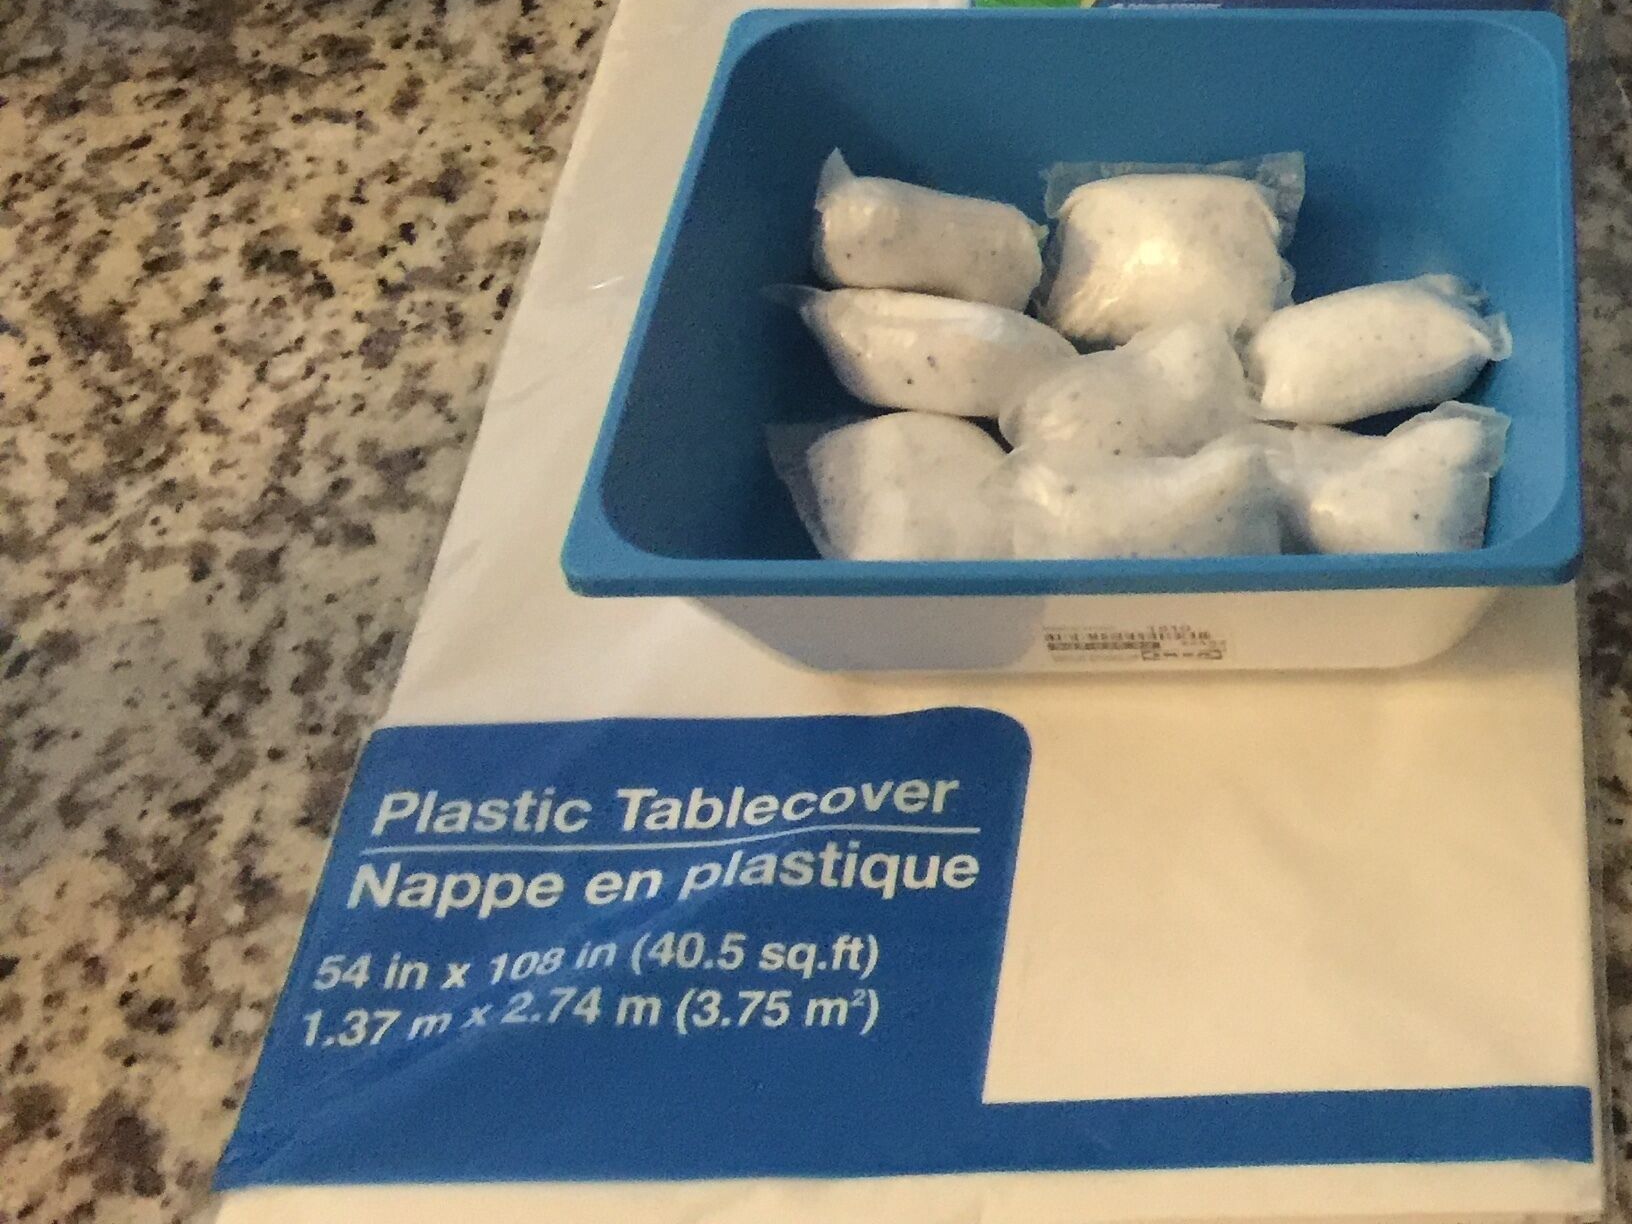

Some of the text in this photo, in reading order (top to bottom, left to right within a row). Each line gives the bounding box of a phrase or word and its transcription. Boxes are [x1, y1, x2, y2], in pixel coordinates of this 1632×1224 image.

[371, 779, 960, 836] Plastic Tablecover
[347, 840, 980, 919] Nappe en plastique
[313, 931, 879, 991] 54 in x 108 in (40.5 sq.ft)
[303, 1008, 401, 1047] 1.37
[407, 1012, 452, 1041] m
[460, 1003, 494, 1028] x
[501, 986, 602, 1025] 2.74
[615, 995, 662, 1026] m
[676, 987, 793, 1035] (3.75
